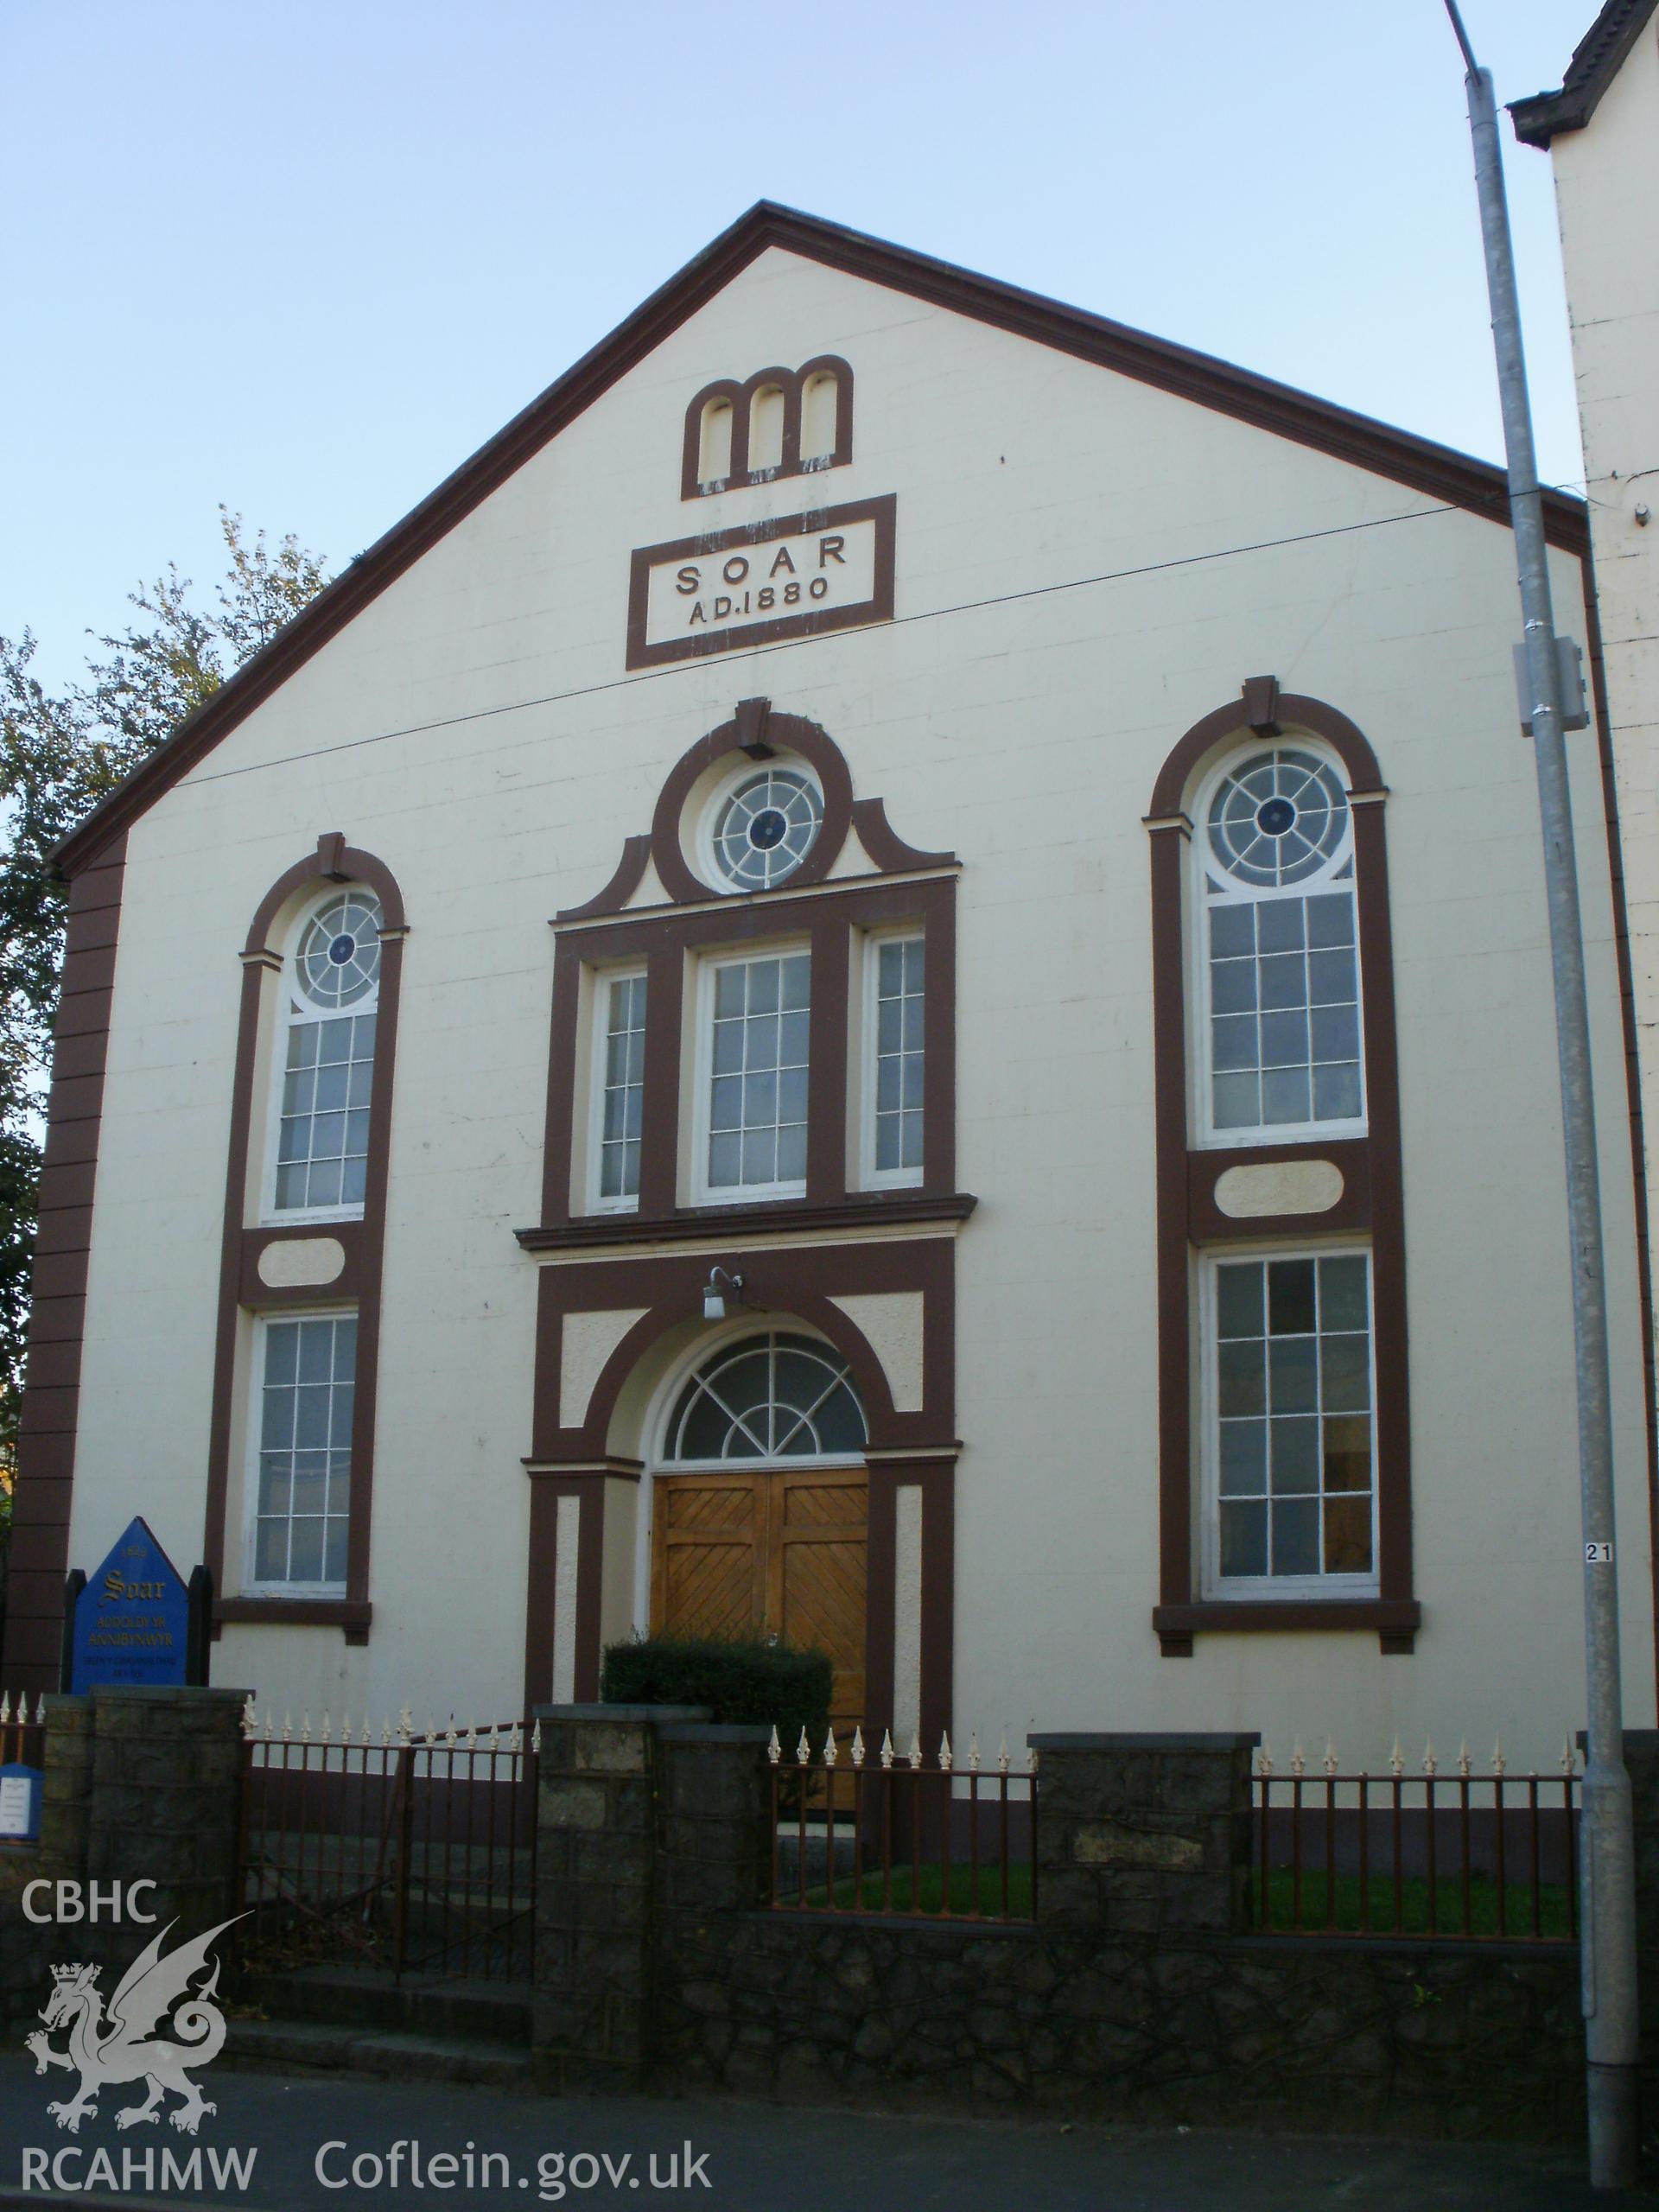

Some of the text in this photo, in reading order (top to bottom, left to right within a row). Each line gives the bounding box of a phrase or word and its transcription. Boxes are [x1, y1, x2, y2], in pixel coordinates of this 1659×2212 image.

[676, 535, 846, 595] SOAR
[1586, 1544, 1610, 1560] 21
[97, 1570, 166, 1608] Soar
[152, 1616, 166, 1629] YR
[88, 1632, 173, 1646] ANNIBYNWYR
